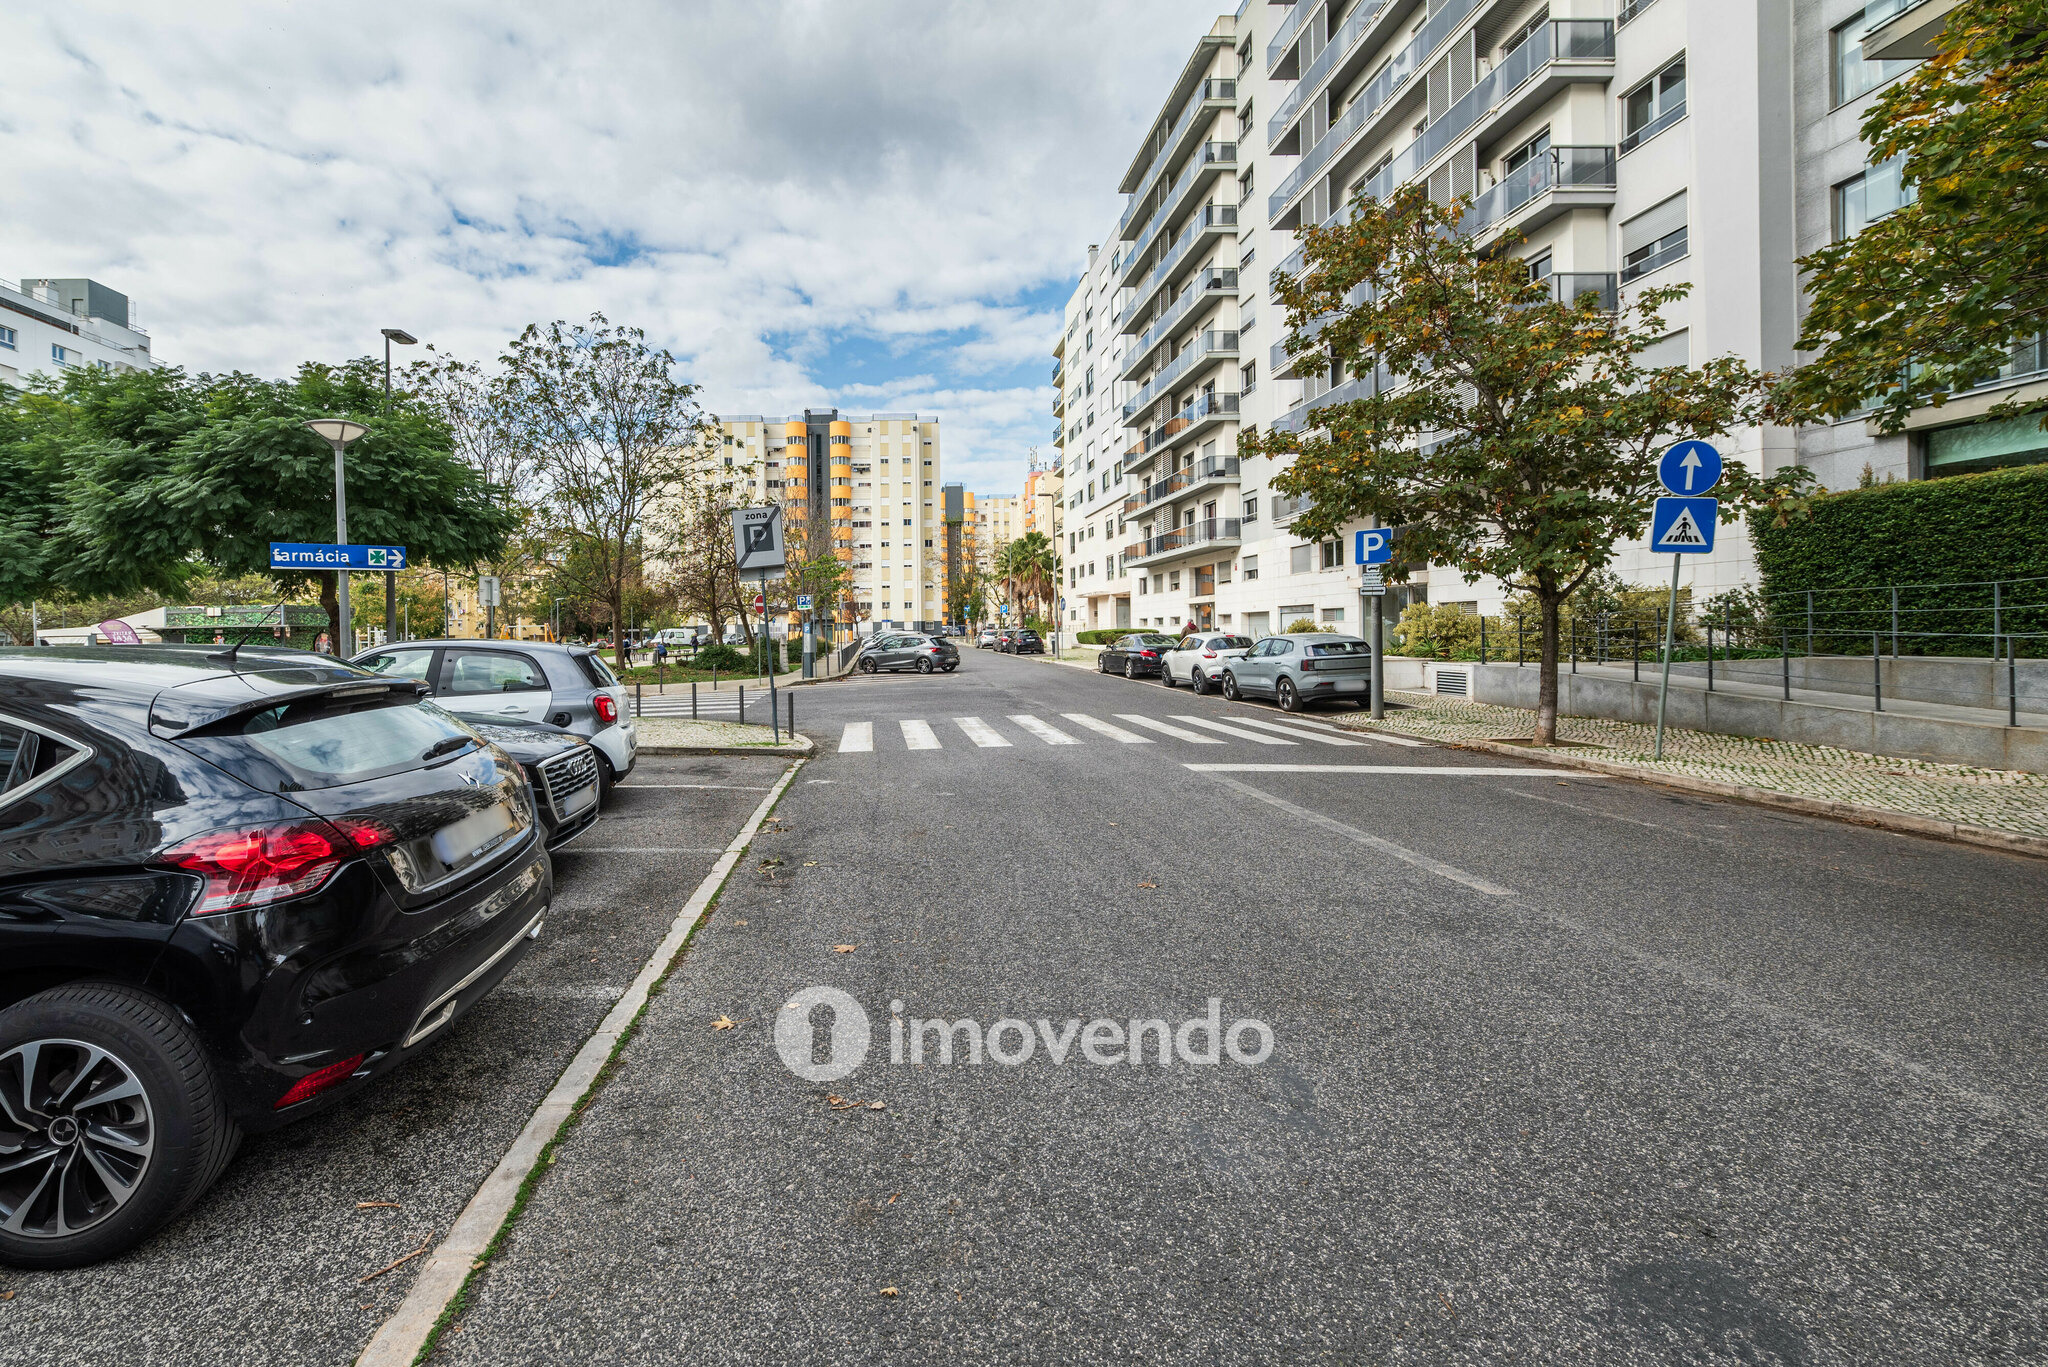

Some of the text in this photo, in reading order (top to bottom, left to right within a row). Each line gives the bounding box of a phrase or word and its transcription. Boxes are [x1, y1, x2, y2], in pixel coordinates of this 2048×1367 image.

[745, 512, 768, 520] zona
[1363, 533, 1384, 561] P
[273, 548, 350, 563] farmácia
